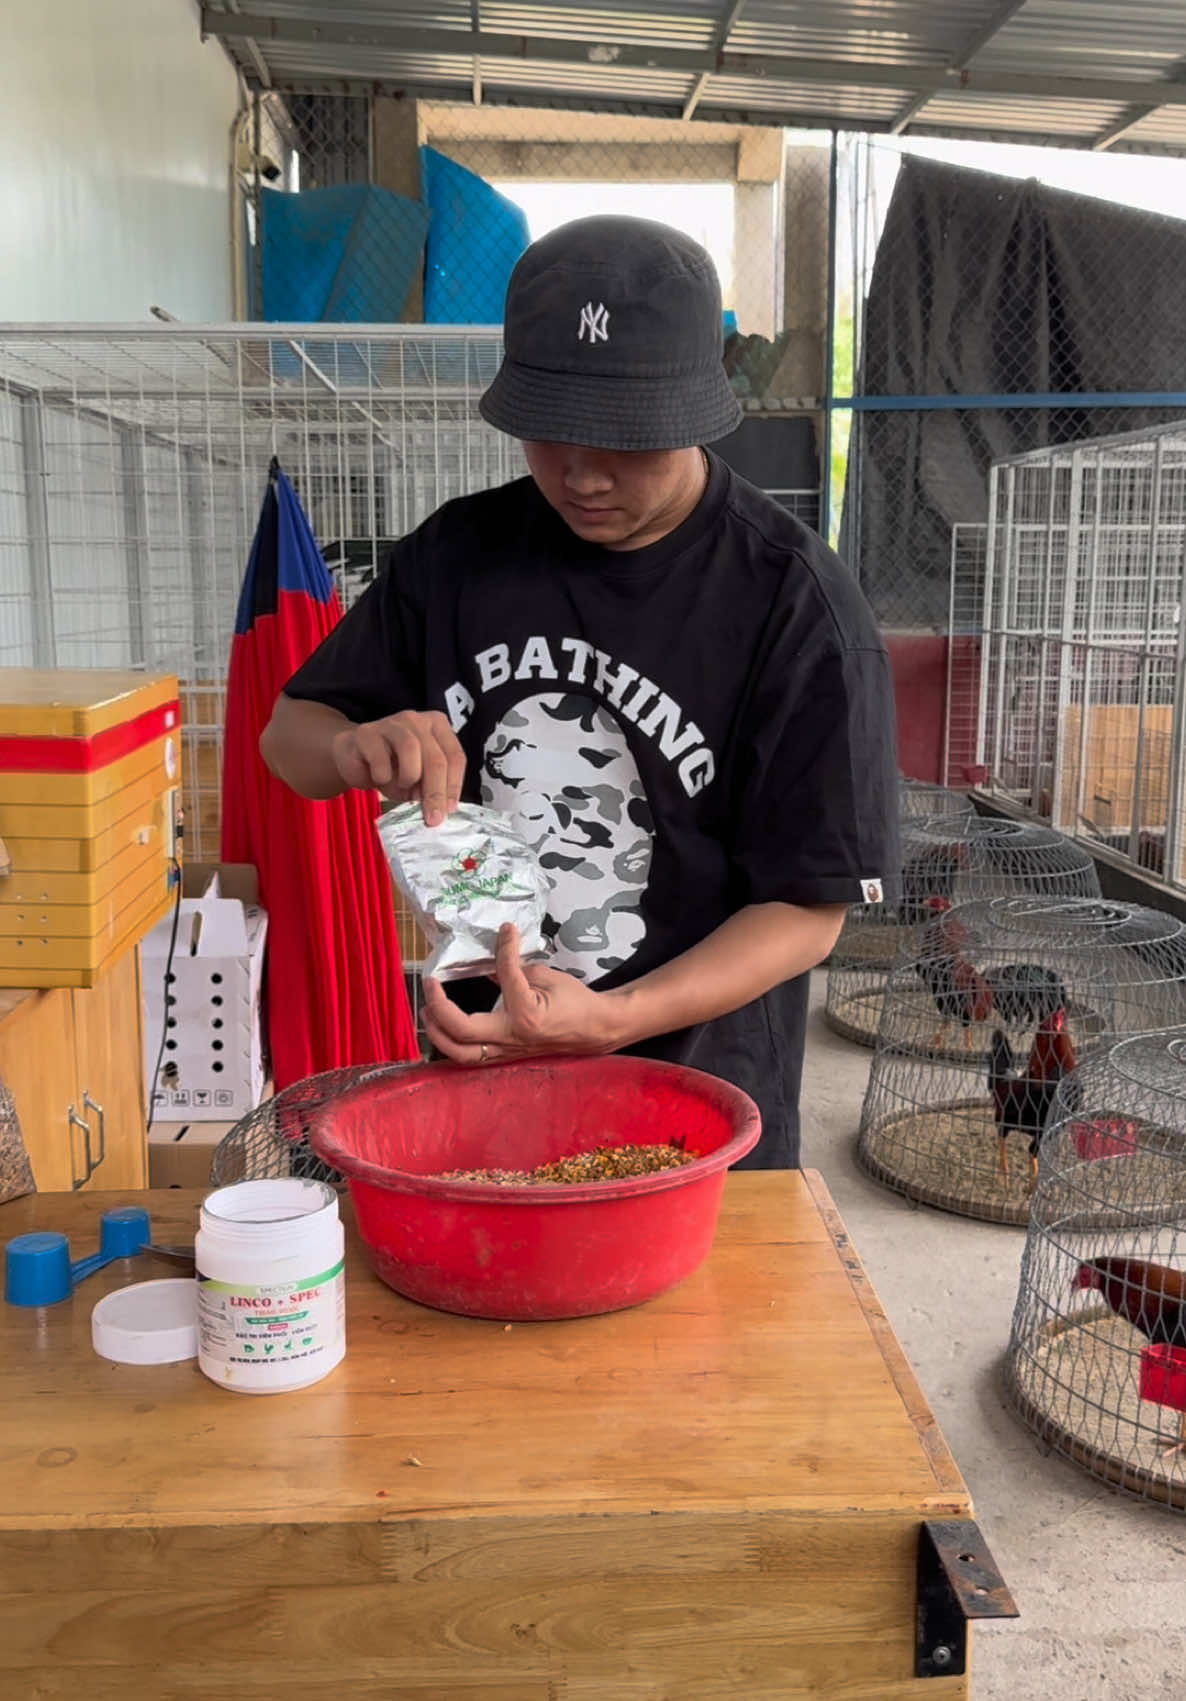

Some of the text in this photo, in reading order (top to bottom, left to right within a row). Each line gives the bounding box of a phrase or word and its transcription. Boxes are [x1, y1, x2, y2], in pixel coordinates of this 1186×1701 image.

[578, 301, 610, 343] NY
[444, 636, 716, 798] A BATHING
[230, 1296, 272, 1308] LINCO
[289, 1288, 321, 1304] SPEC
